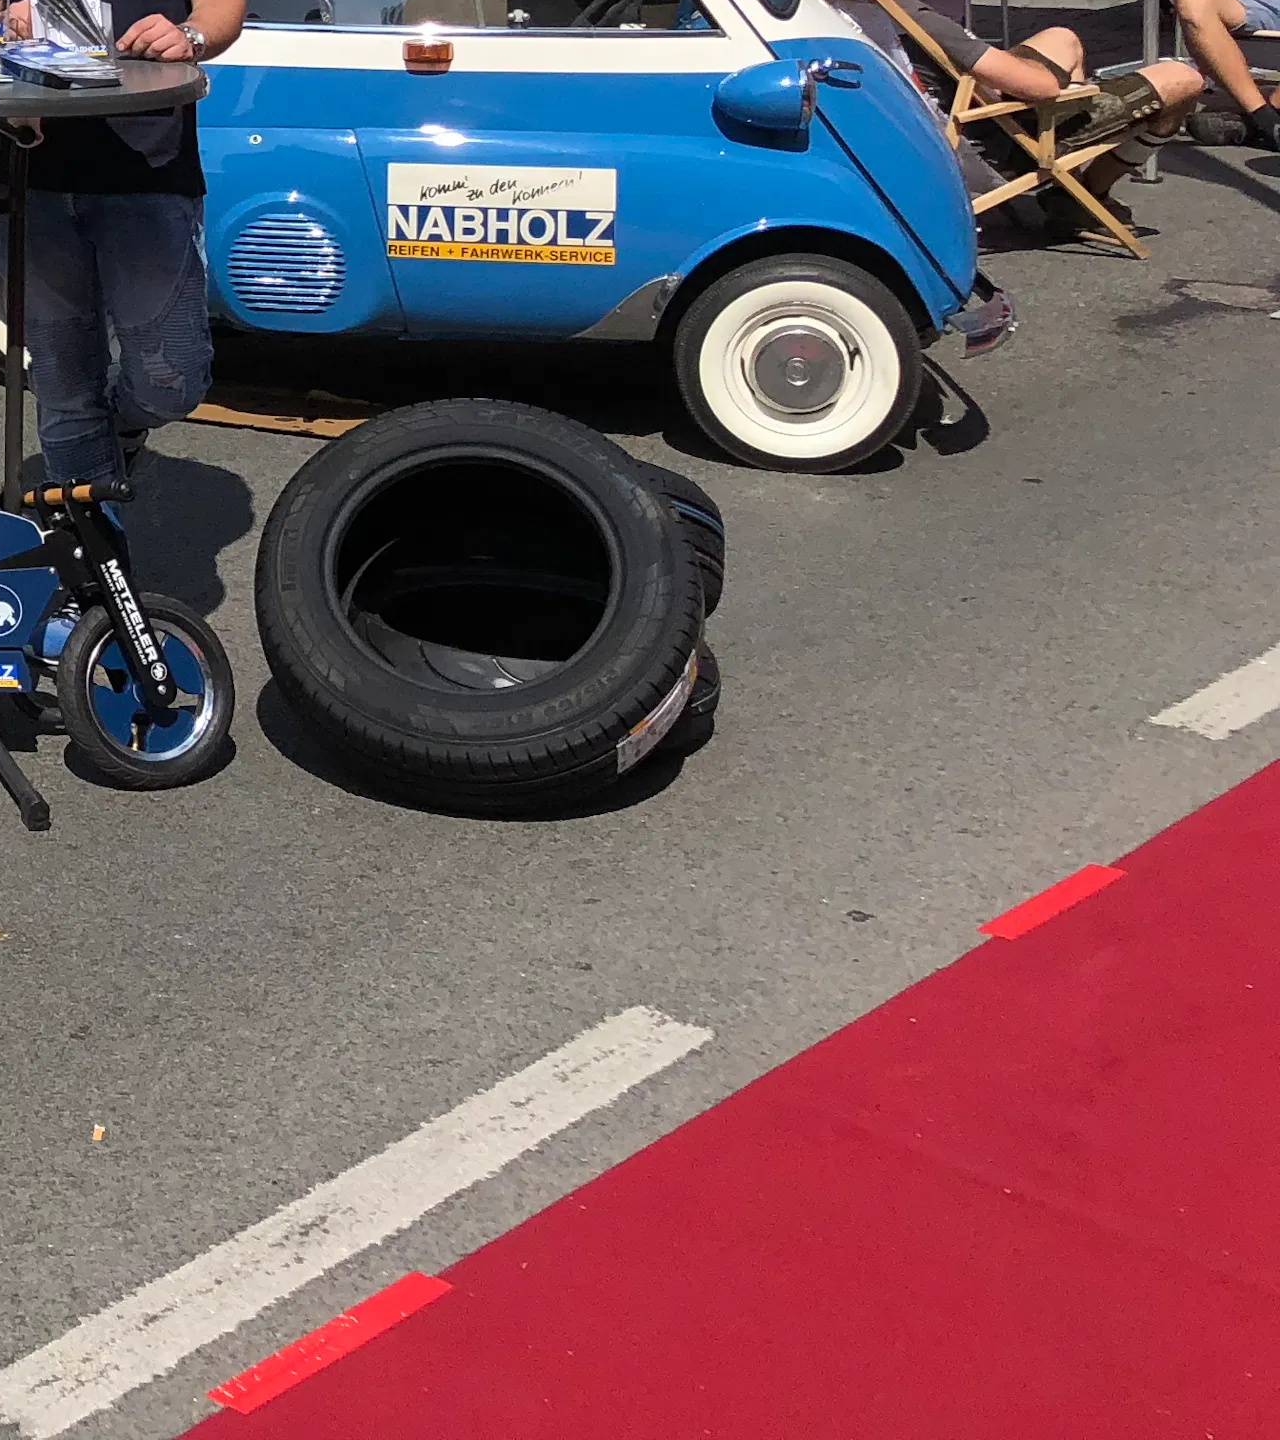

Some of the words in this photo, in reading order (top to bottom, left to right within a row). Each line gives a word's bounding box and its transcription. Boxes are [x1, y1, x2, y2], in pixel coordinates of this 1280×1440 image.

[466, 187, 484, 201] zu
[489, 178, 517, 195] den
[388, 205, 614, 247] NABHOLZ
[388, 244, 440, 257] REIFEN
[461, 247, 613, 263] FAHRWERK-SERVICE
[100, 564, 116, 592] ALWAYS
[113, 592, 124, 610] TWO
[120, 609, 137, 639] WHEELS
[133, 640, 148, 665] AHEAD
[106, 559, 159, 663] METZELER
